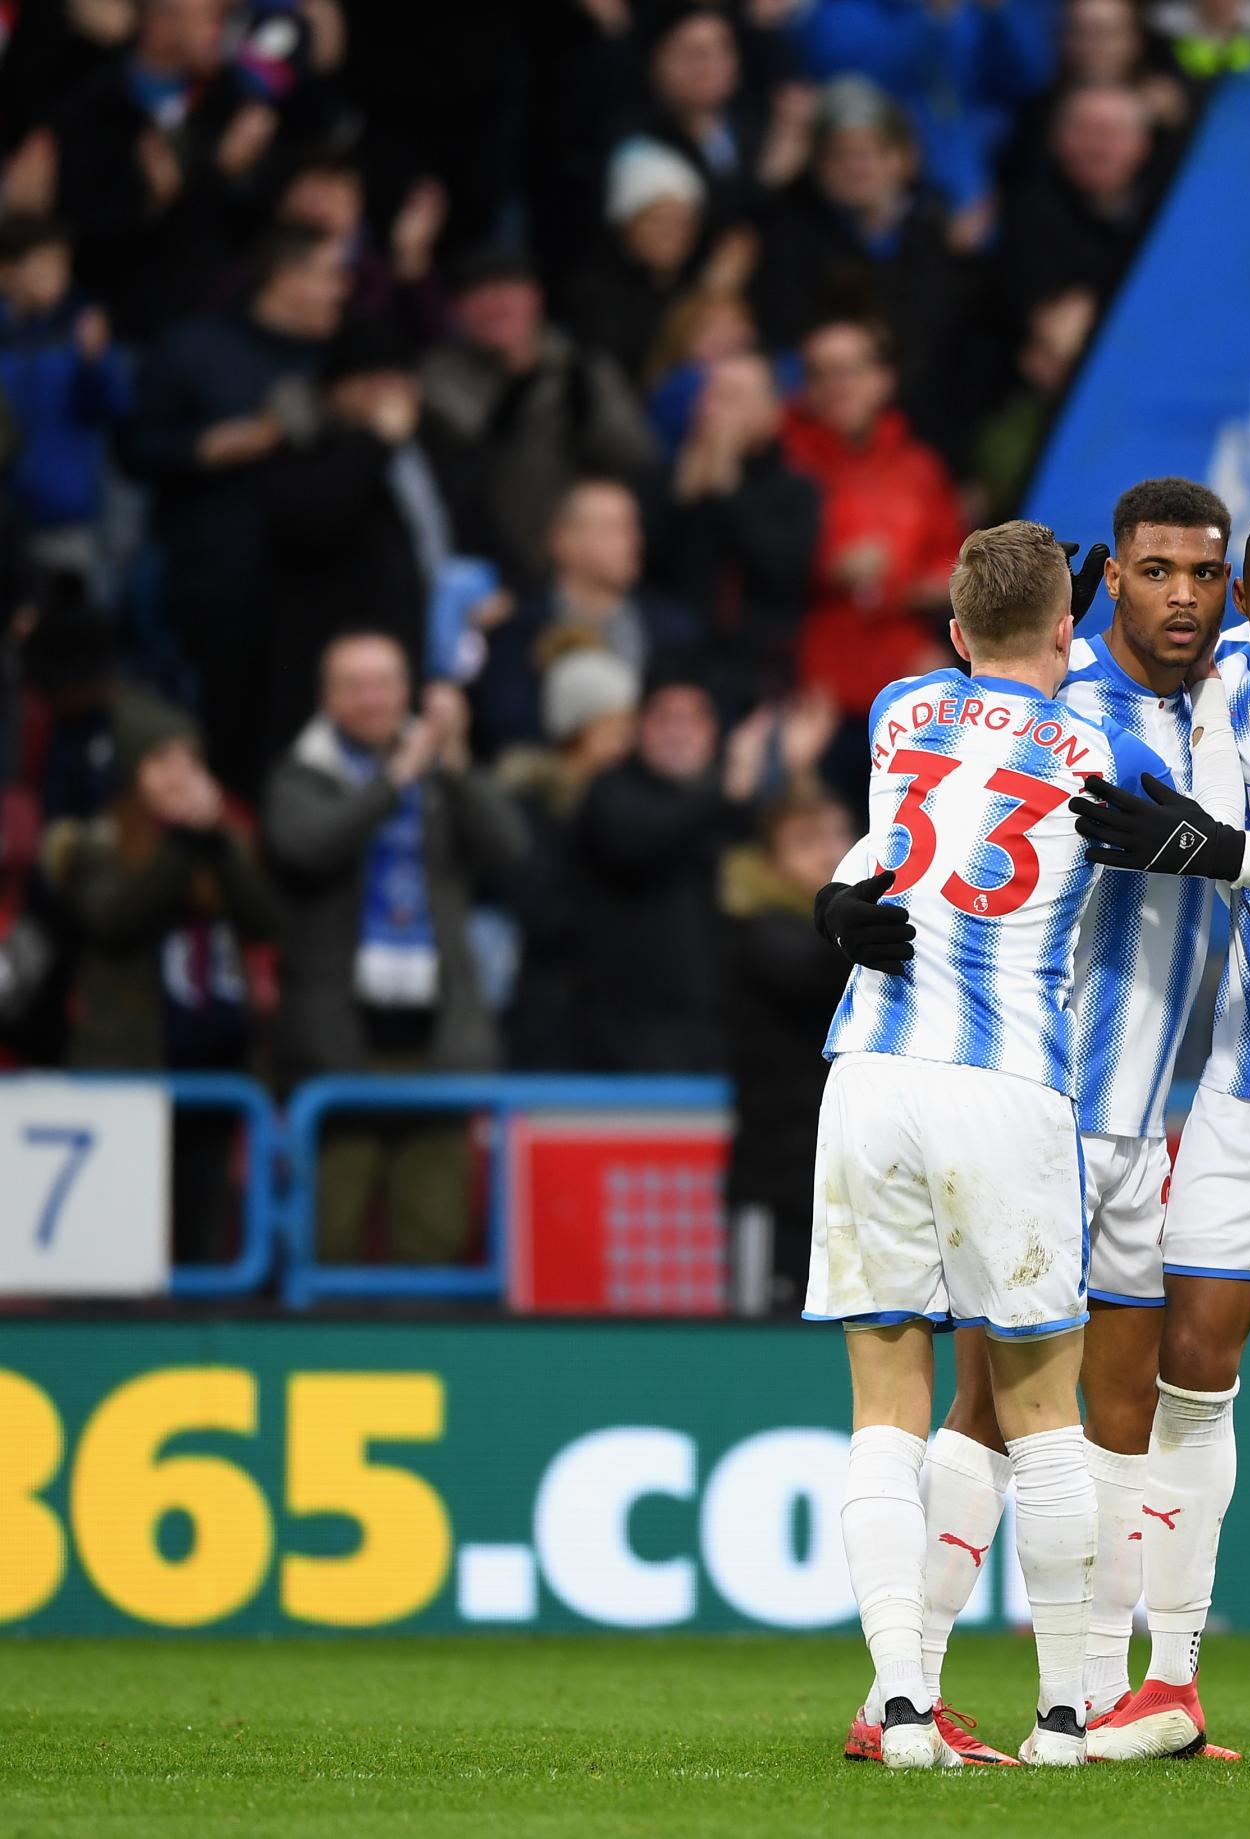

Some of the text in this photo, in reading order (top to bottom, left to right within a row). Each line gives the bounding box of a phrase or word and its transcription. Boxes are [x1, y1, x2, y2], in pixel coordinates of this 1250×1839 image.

[872, 698, 1107, 808] HADERGJONA
[876, 749, 1072, 917] 33
[22, 1124, 95, 1249] 7
[0, 1362, 1040, 1628] 65.co
